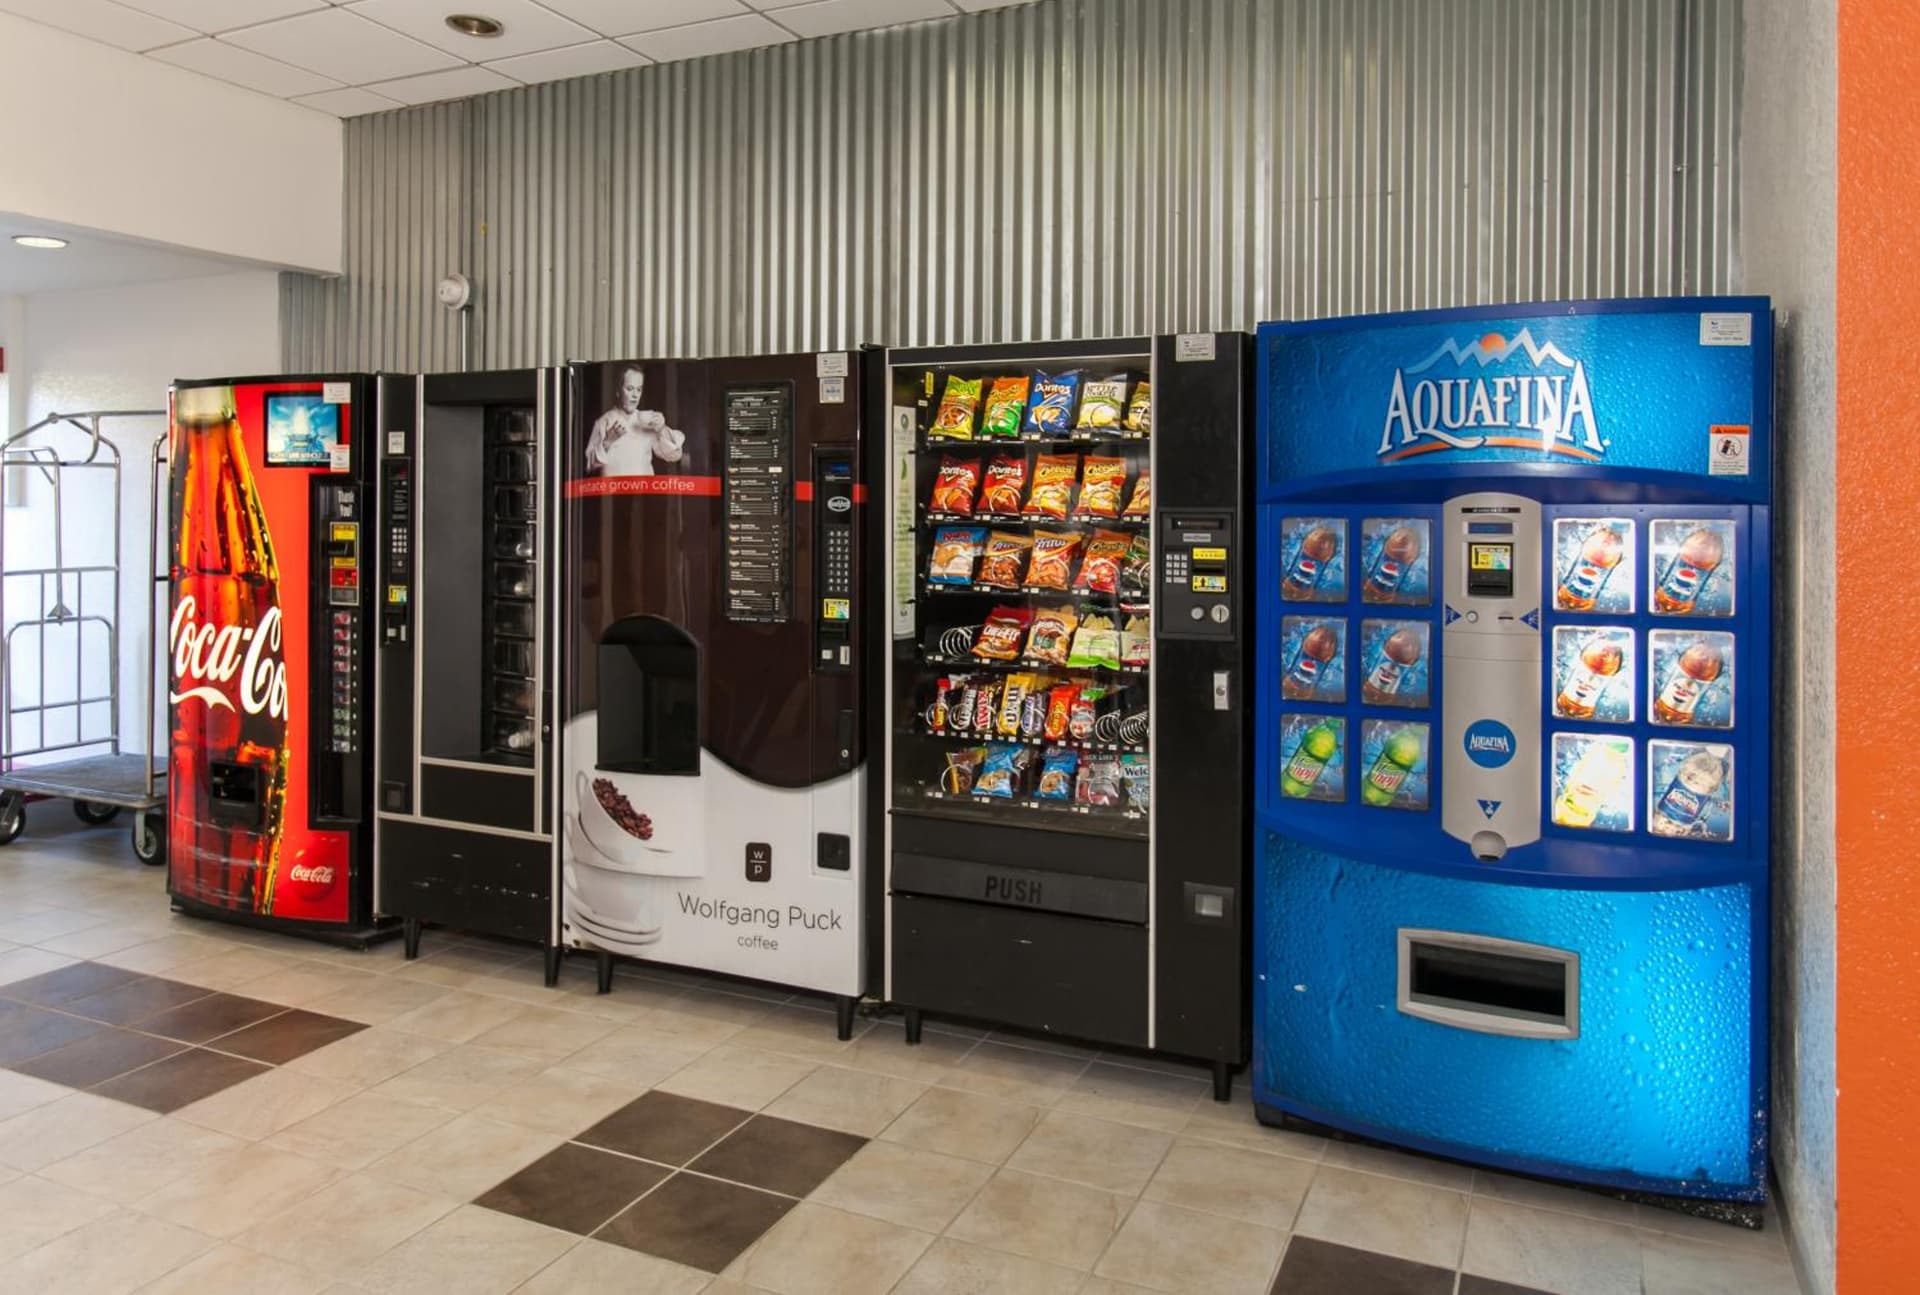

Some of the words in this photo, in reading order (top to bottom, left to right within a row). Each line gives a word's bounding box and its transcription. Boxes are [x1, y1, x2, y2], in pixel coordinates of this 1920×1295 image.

[1034, 383, 1071, 395] Doritos
[1377, 360, 1605, 455] AQUAFINA
[608, 480, 648, 493] grown
[652, 478, 695, 492] coffee
[985, 875, 1042, 905] PUSH
[677, 891, 780, 929] Wolfgang
[788, 904, 842, 931] Puck
[736, 935, 779, 951] coffee
